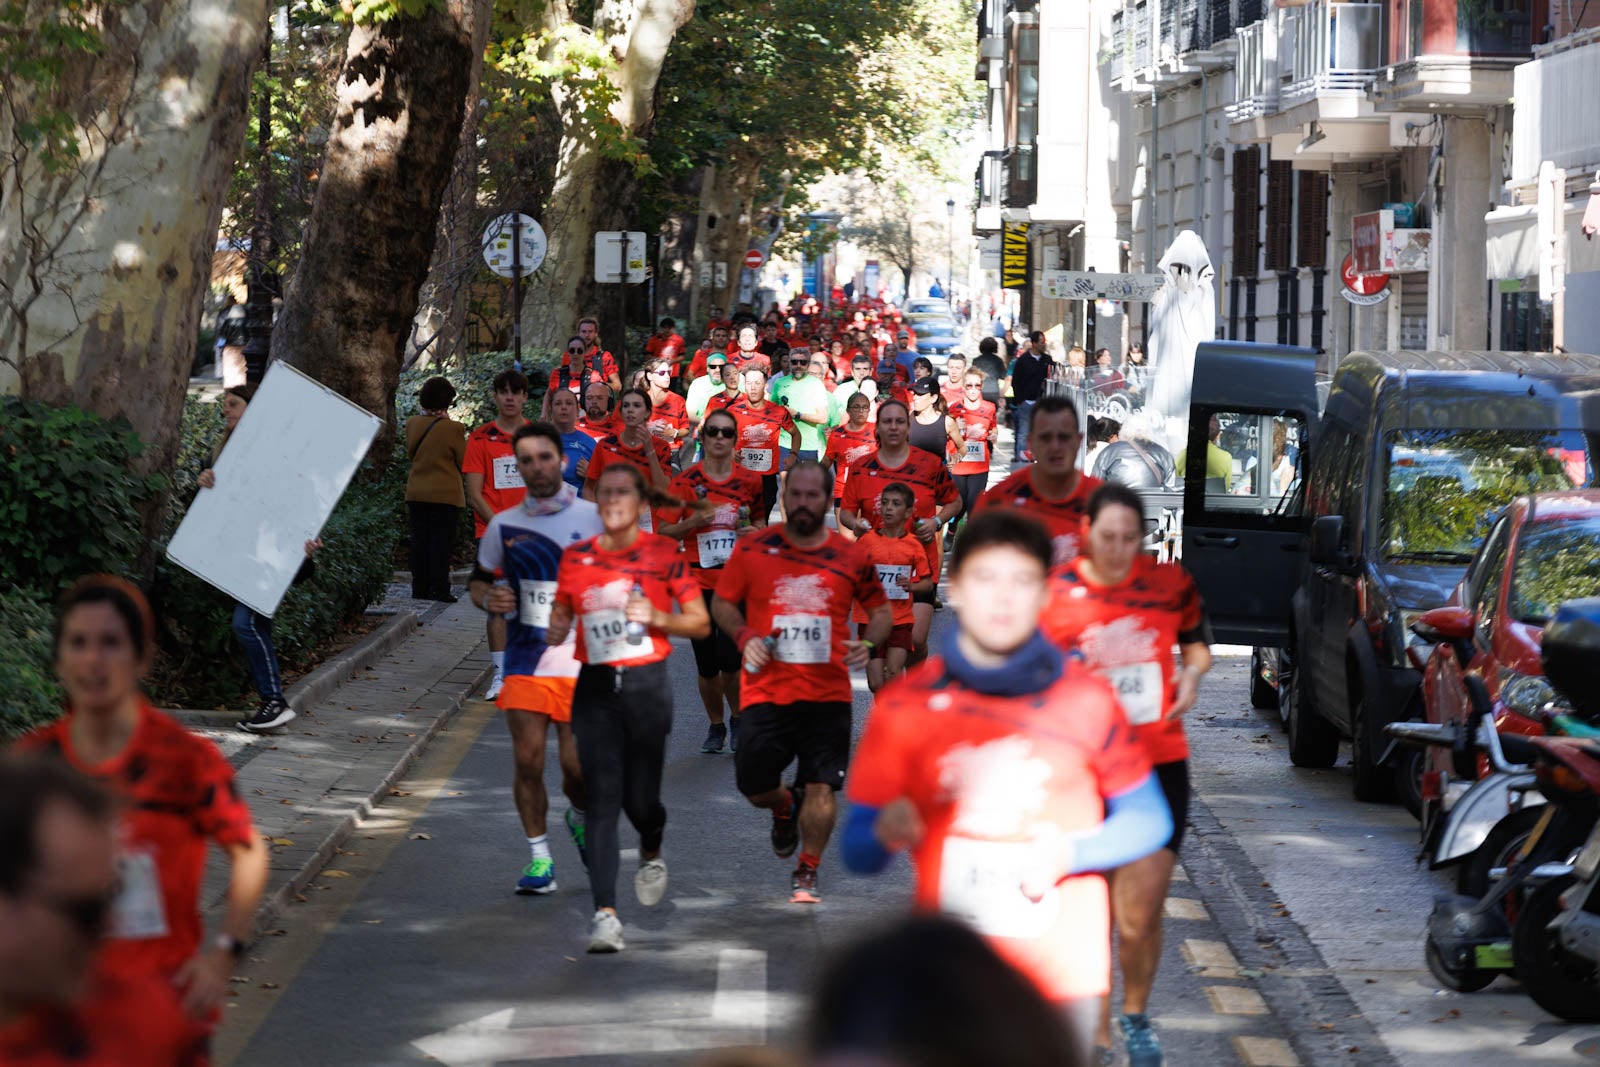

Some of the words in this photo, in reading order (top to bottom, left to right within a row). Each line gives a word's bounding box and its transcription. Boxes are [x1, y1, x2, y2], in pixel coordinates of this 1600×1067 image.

[748, 453, 764, 461] 992
[705, 538, 735, 550] 1777
[782, 627, 821, 641] 1716
